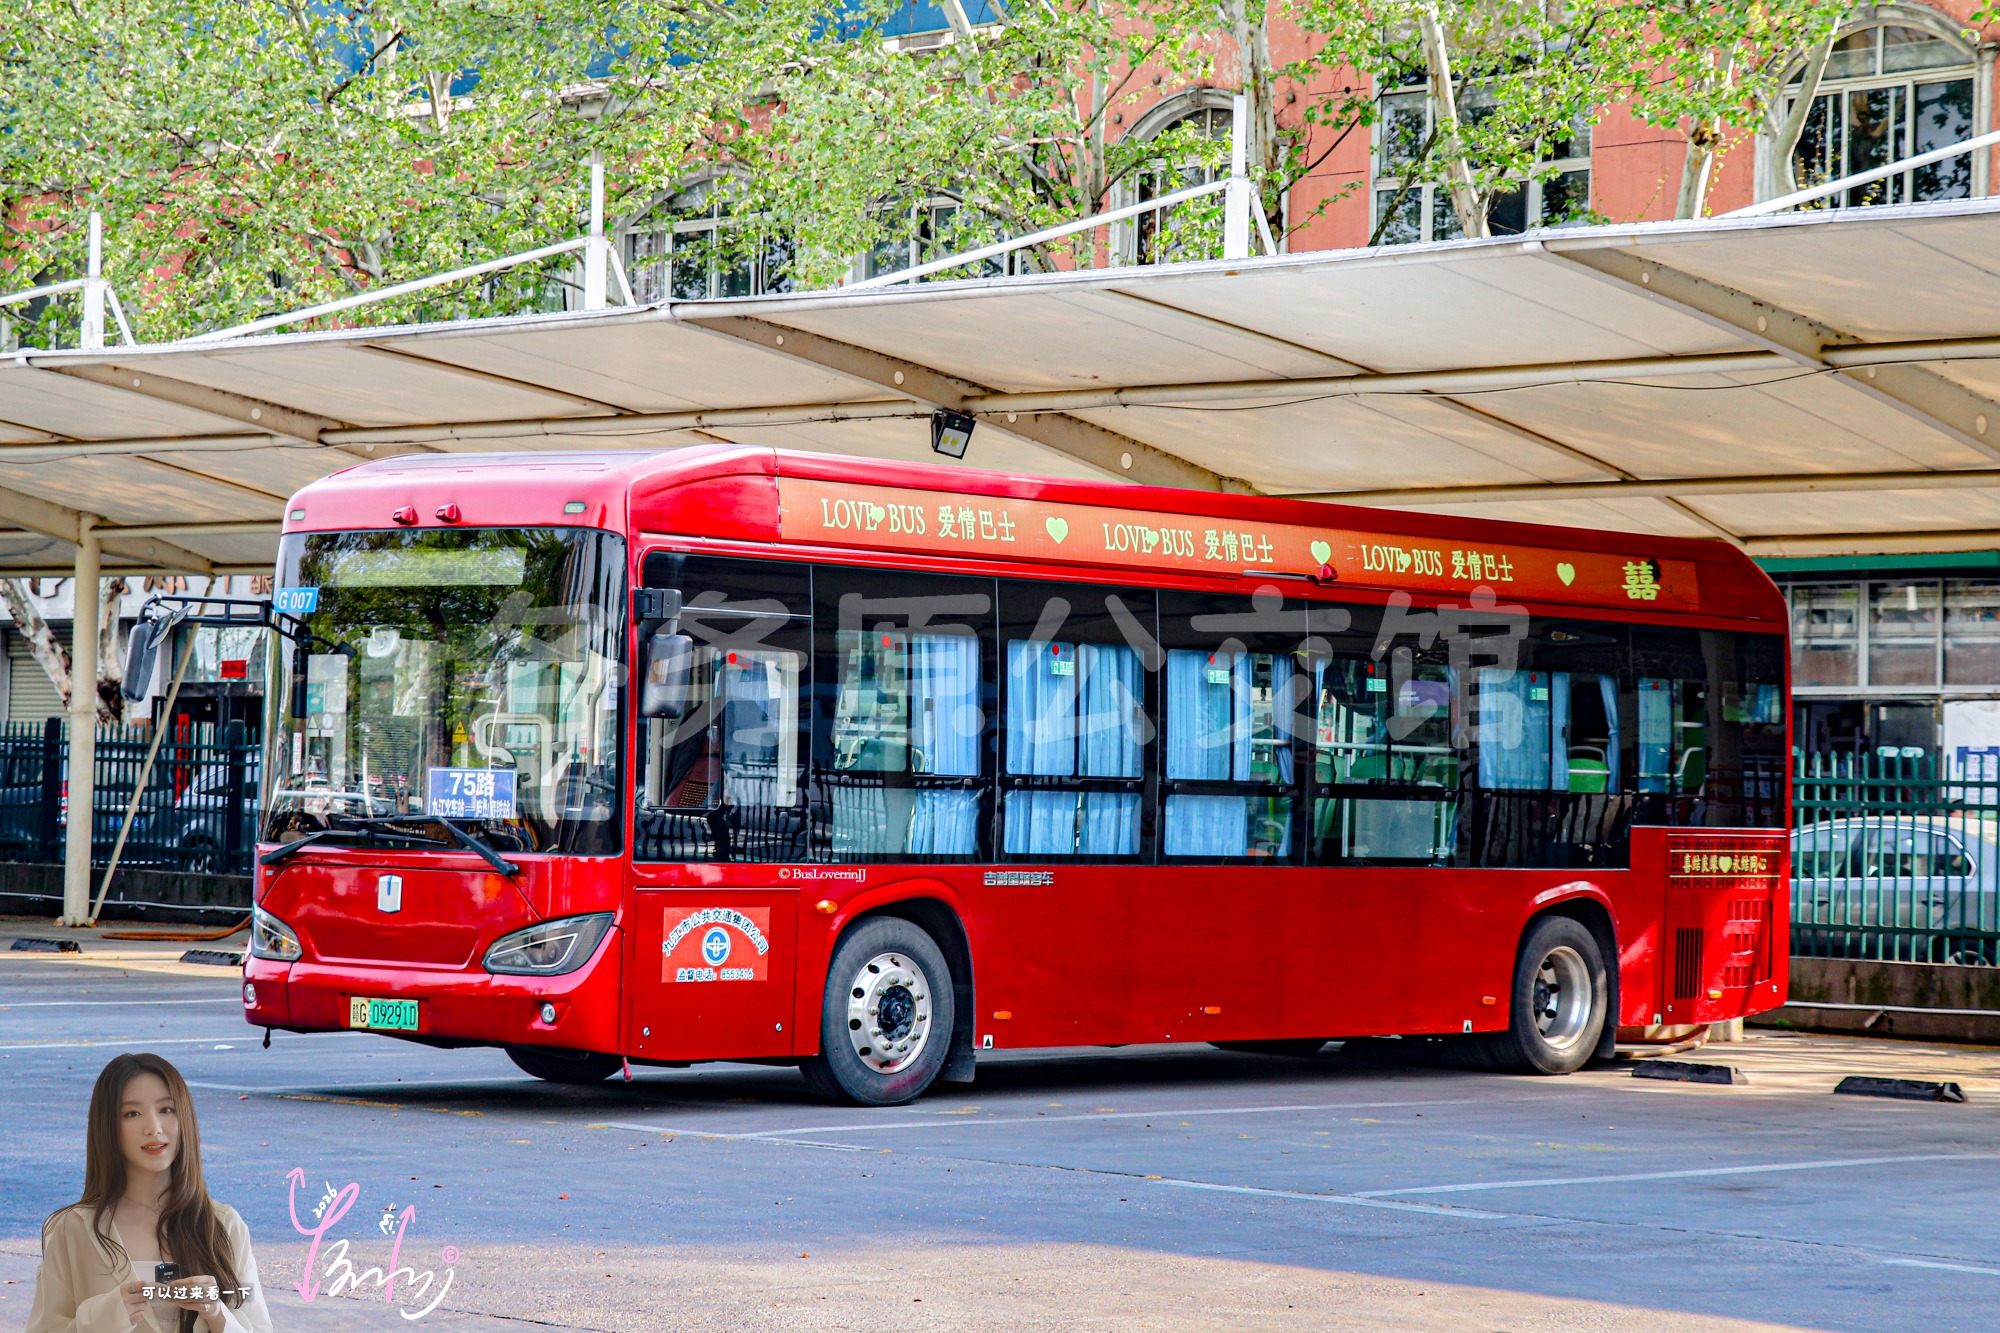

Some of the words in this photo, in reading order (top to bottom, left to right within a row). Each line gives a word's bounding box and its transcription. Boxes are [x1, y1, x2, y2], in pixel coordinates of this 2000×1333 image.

[821, 498, 878, 531] LOVE
[887, 504, 926, 535] BUS
[938, 505, 1016, 542] 爱情巴士
[1103, 523, 1153, 553] LOVE
[1160, 528, 1195, 557] BUS
[1205, 529, 1274, 563] 爱情巴士
[1361, 544, 1406, 573] LOVE
[1412, 549, 1443, 576] BUS
[1451, 550, 1514, 582] 爱情巴士
[278, 591, 289, 610] G
[290, 591, 314, 609] 007
[449, 771, 495, 798] 75路
[662, 907, 770, 957] 九江市公共交通集团公司
